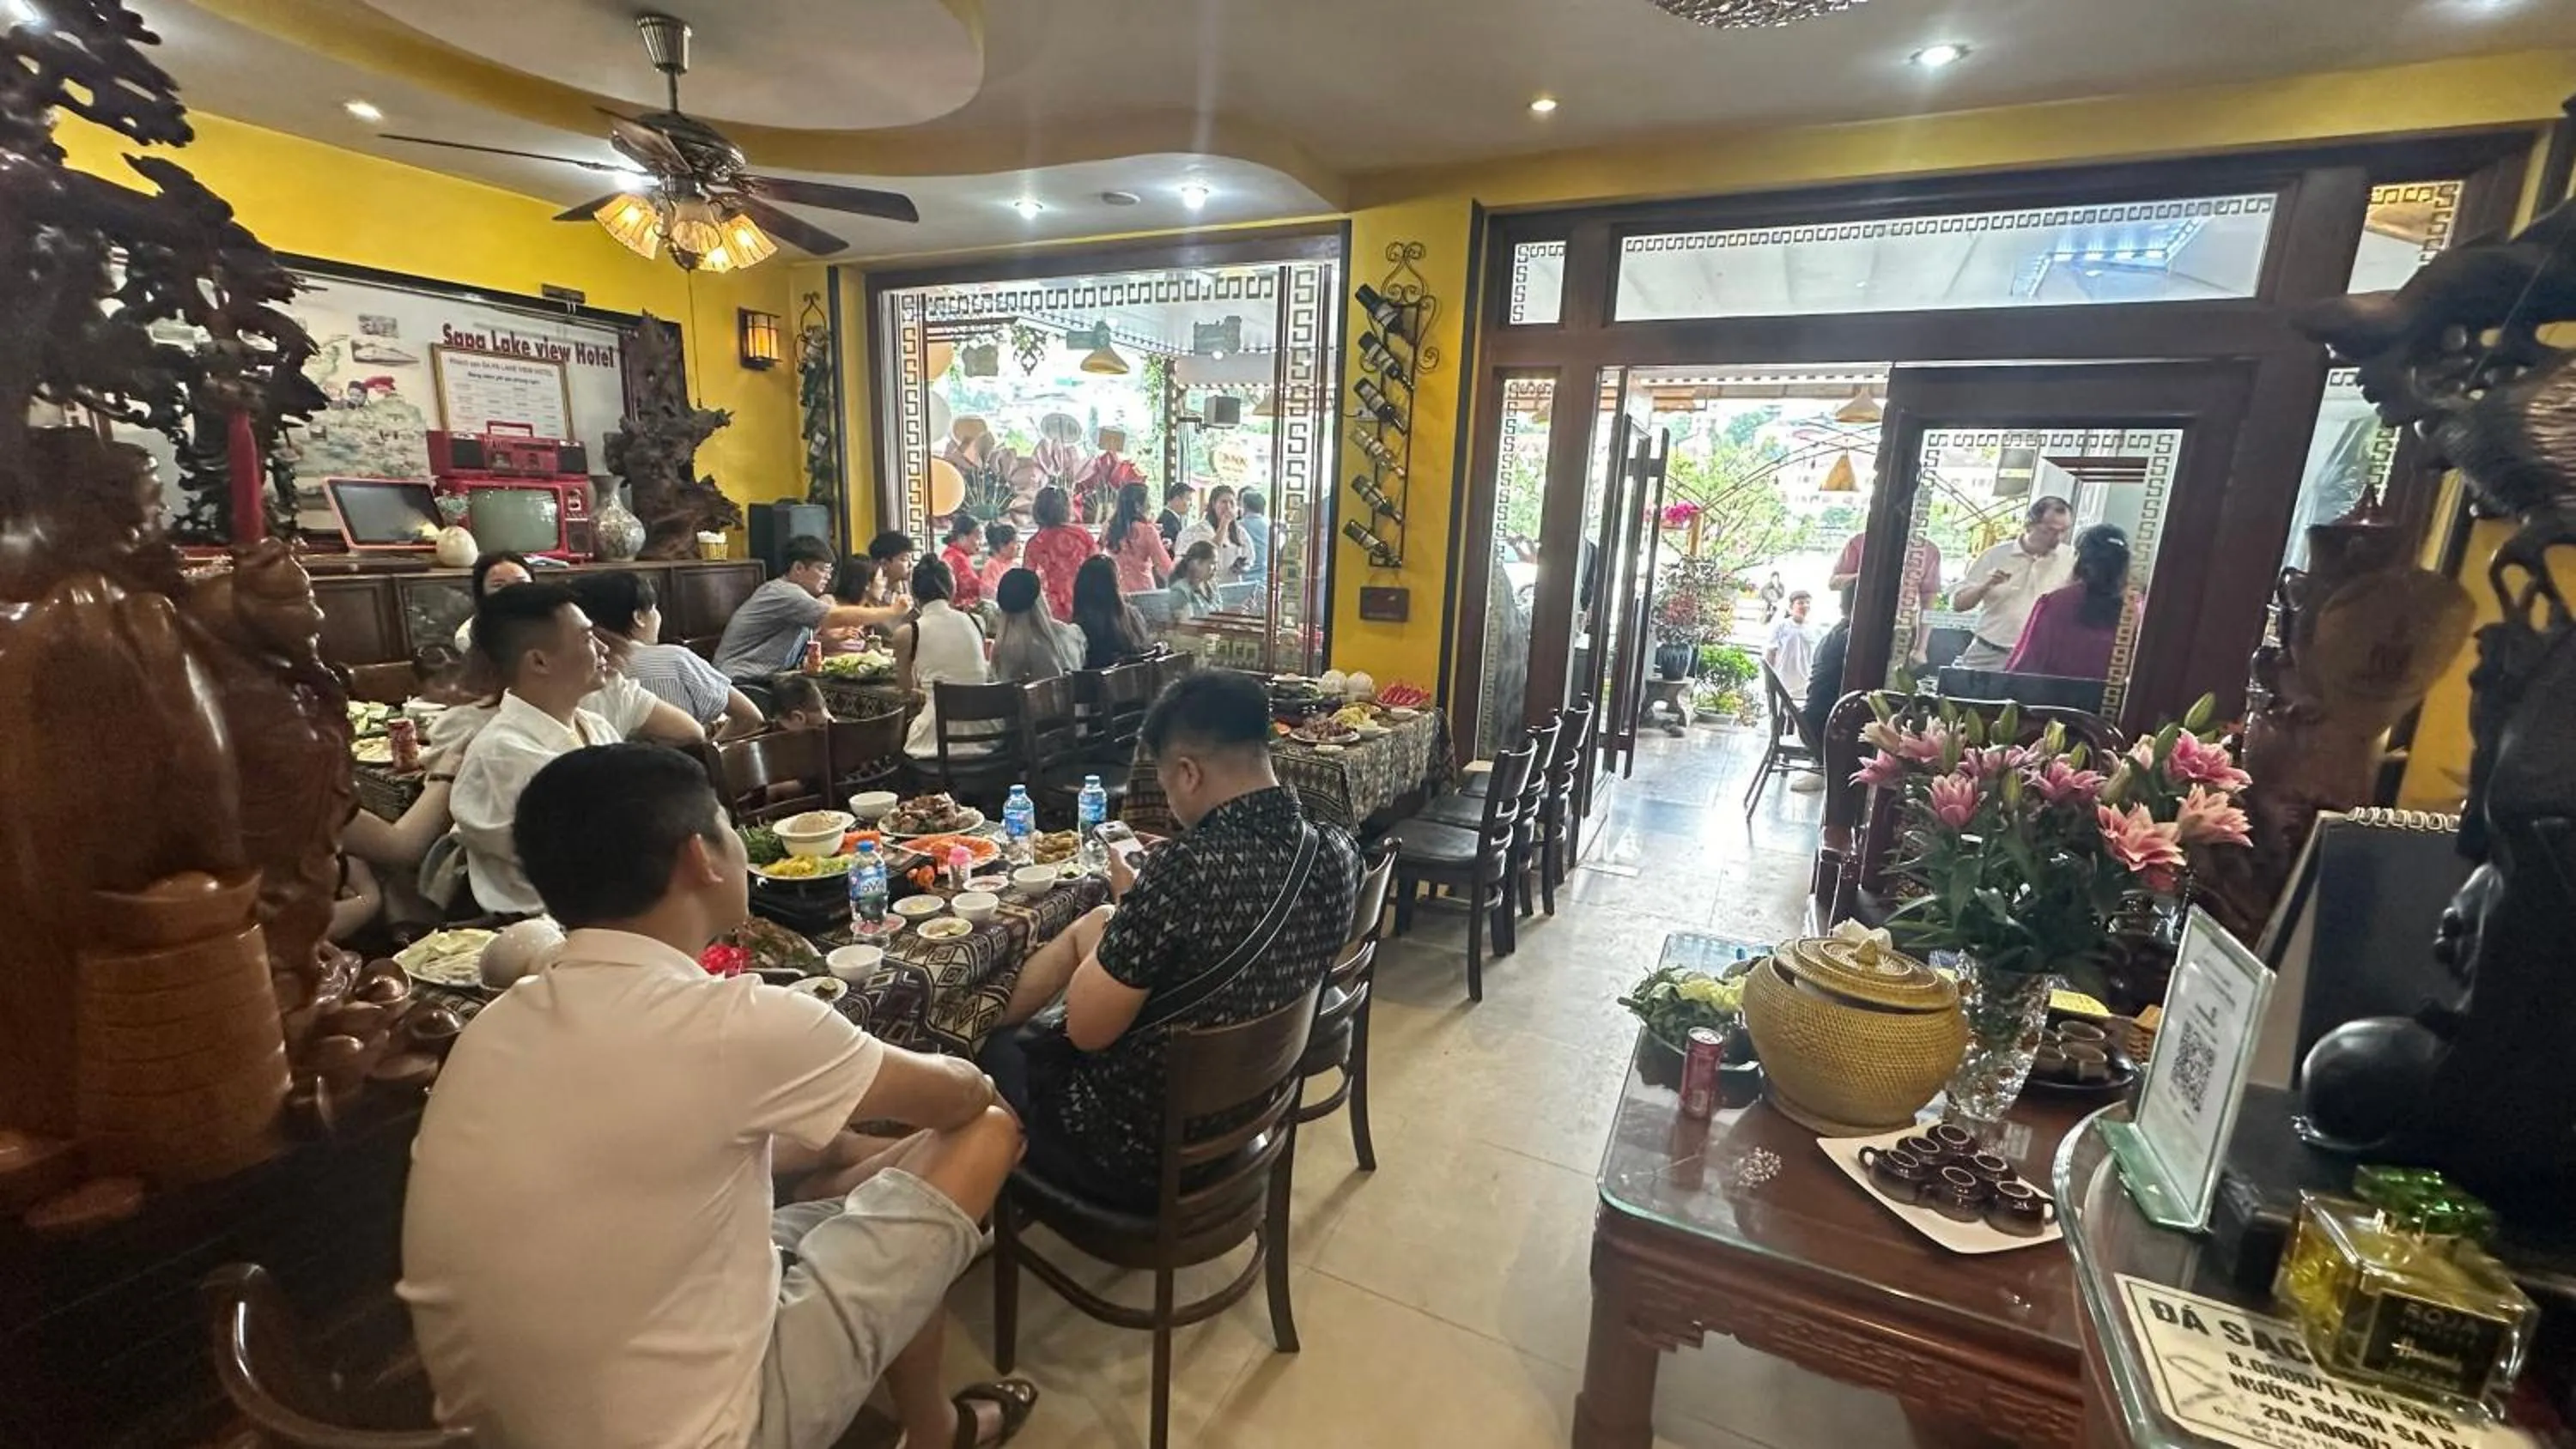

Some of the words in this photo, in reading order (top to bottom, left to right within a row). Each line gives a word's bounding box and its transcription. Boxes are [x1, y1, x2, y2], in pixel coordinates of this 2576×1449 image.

[442, 323, 486, 349] Sapa
[491, 329, 532, 356] Lake
[536, 336, 571, 362] view
[575, 342, 614, 368] Hotel
[2148, 1298, 2211, 1337] ĐÁ
[2219, 1319, 2313, 1367] SẠC
